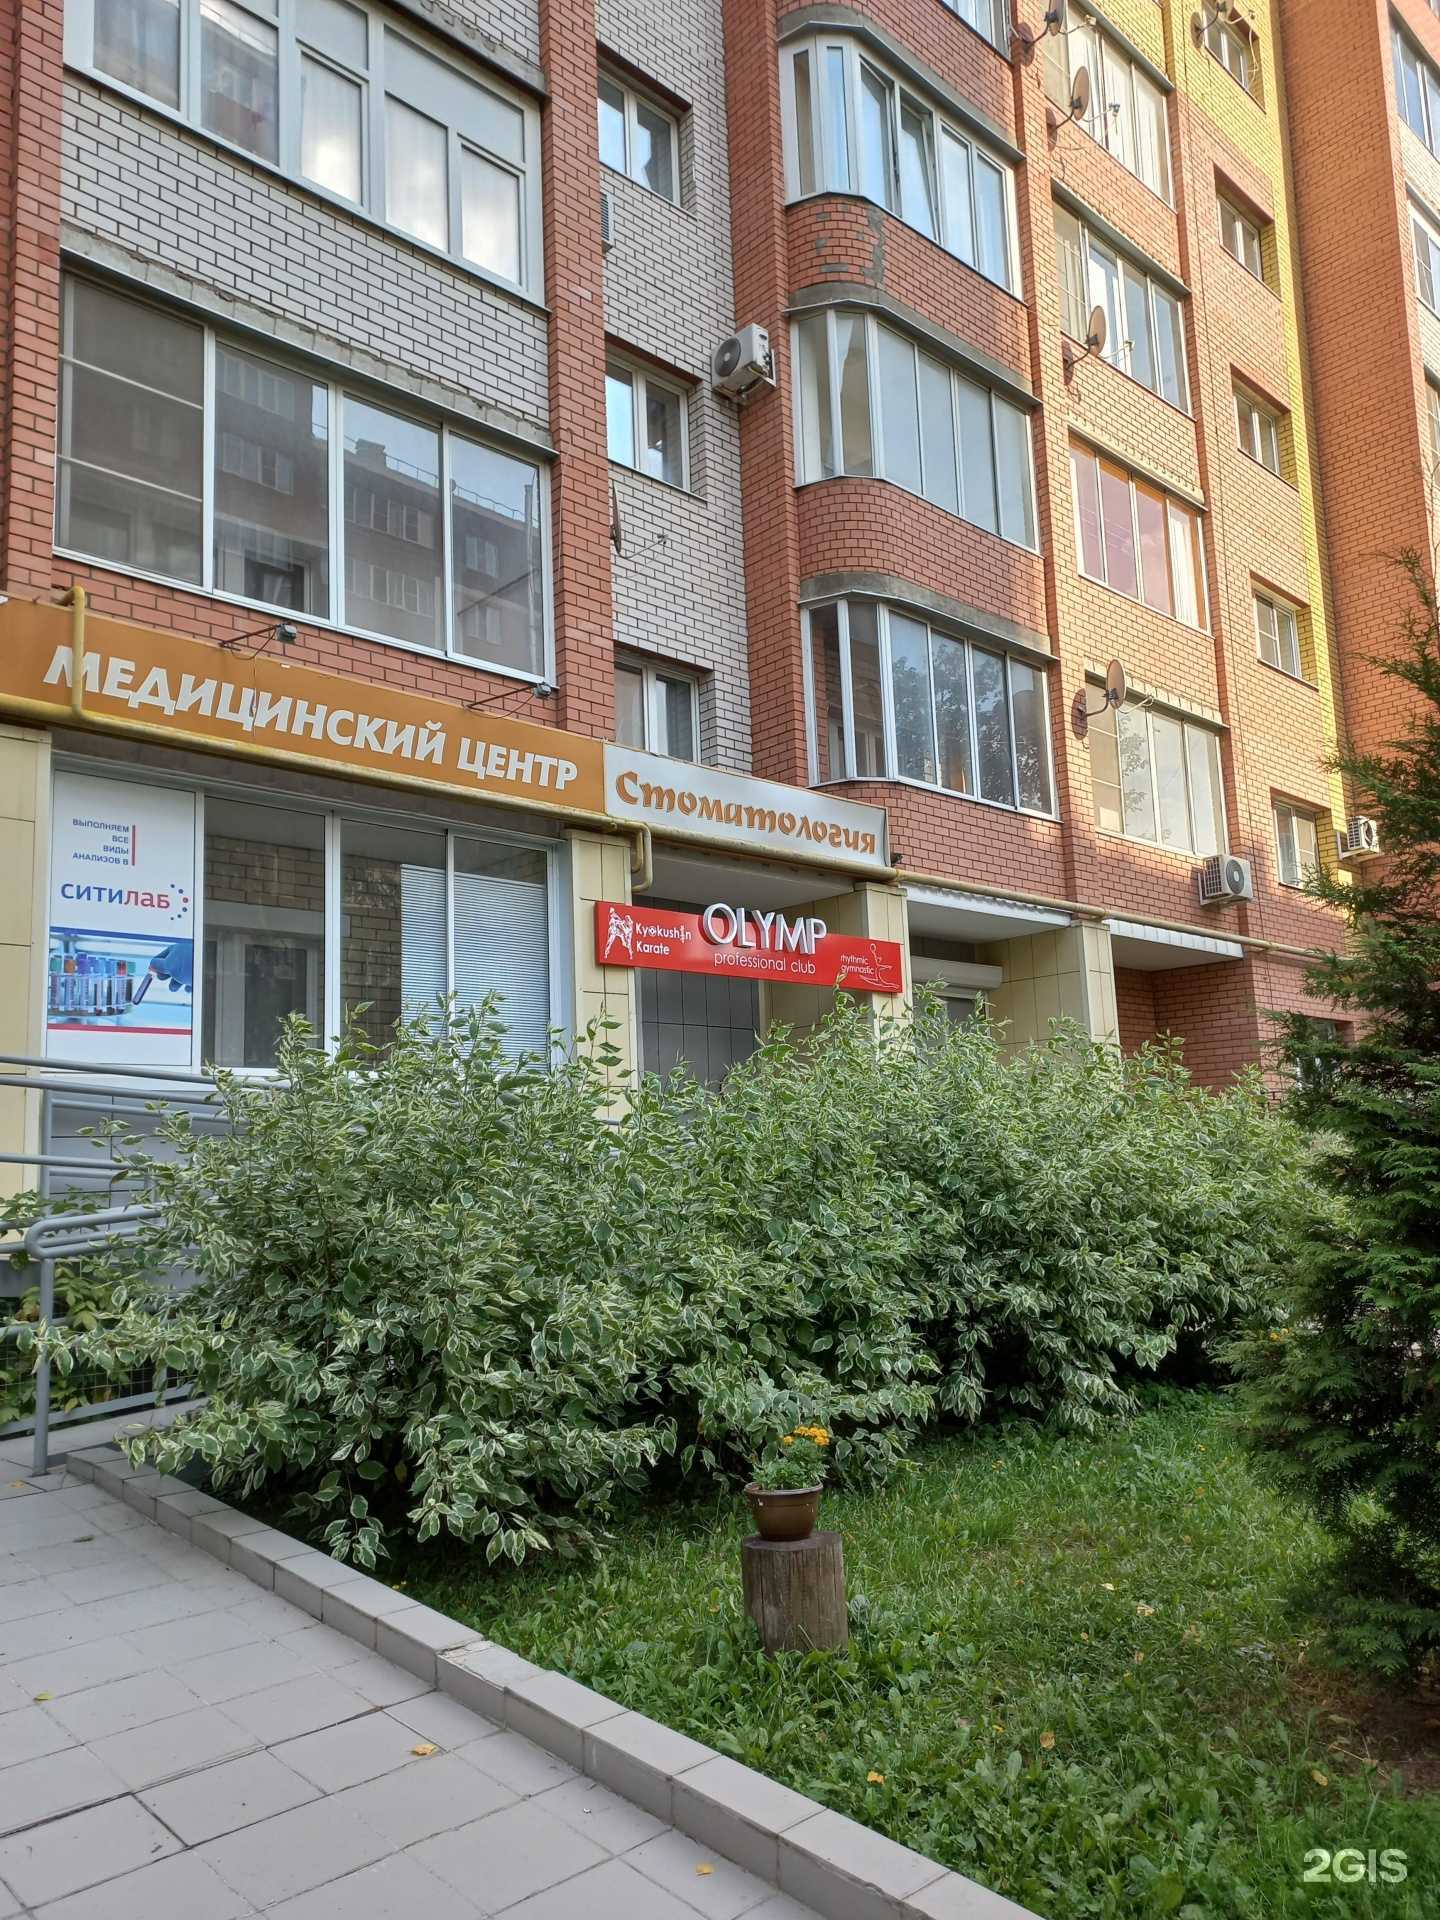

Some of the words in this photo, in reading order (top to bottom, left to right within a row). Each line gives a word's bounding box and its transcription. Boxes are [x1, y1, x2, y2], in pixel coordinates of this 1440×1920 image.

[43, 645, 446, 765] МЕДИЦИНСКИЙ
[456, 737, 579, 791] ЦЕНТР
[615, 771, 876, 855] Стоматология
[72, 818, 130, 833] ВЫПОЛНЯЕМ
[112, 835, 129, 844] ВСЕ
[103, 845, 129, 855] ВИДЫ
[72, 852, 121, 864] АНАЛИЗОВ
[122, 858, 129, 866] В
[635, 922, 692, 944] Kyokushin
[703, 903, 828, 955] OLYMP
[636, 940, 671, 956] Karate
[713, 951, 787, 972] professional
[790, 959, 817, 975] club
[840, 953, 869, 966] rhythmic
[841, 964, 875, 975] gymnastic
